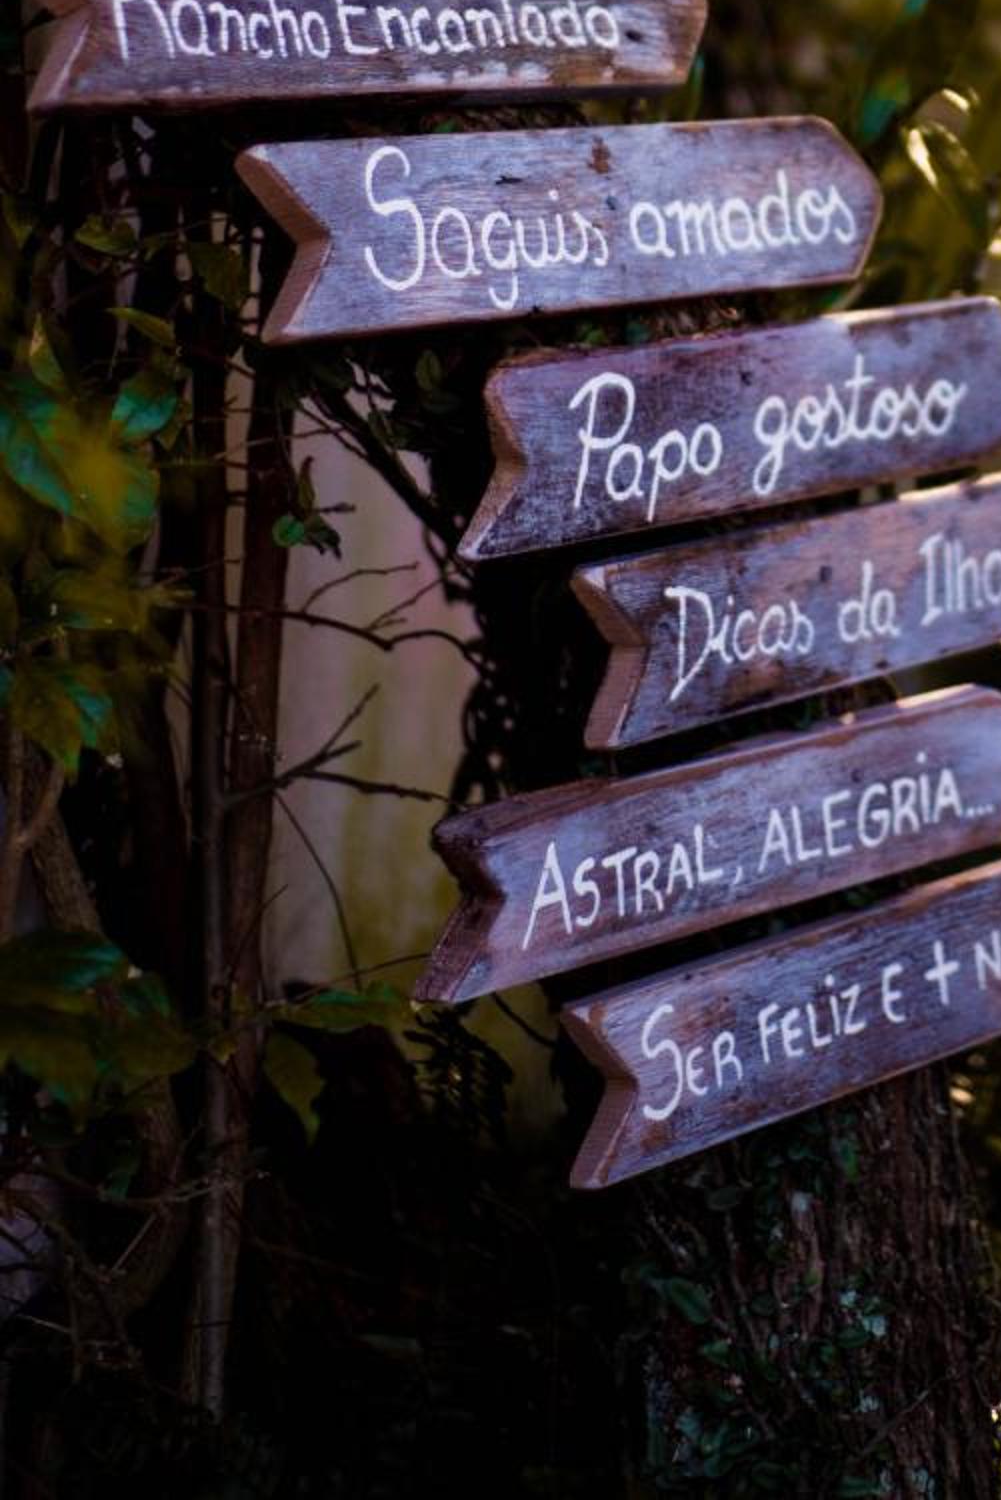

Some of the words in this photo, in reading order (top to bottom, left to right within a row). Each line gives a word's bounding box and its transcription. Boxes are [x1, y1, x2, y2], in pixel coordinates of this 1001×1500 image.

[363, 146, 610, 309] Saguis
[630, 169, 855, 258] amados
[568, 371, 721, 523] Papo
[753, 353, 966, 497] gostoso
[664, 586, 815, 701] Dicas
[838, 561, 898, 643] da
